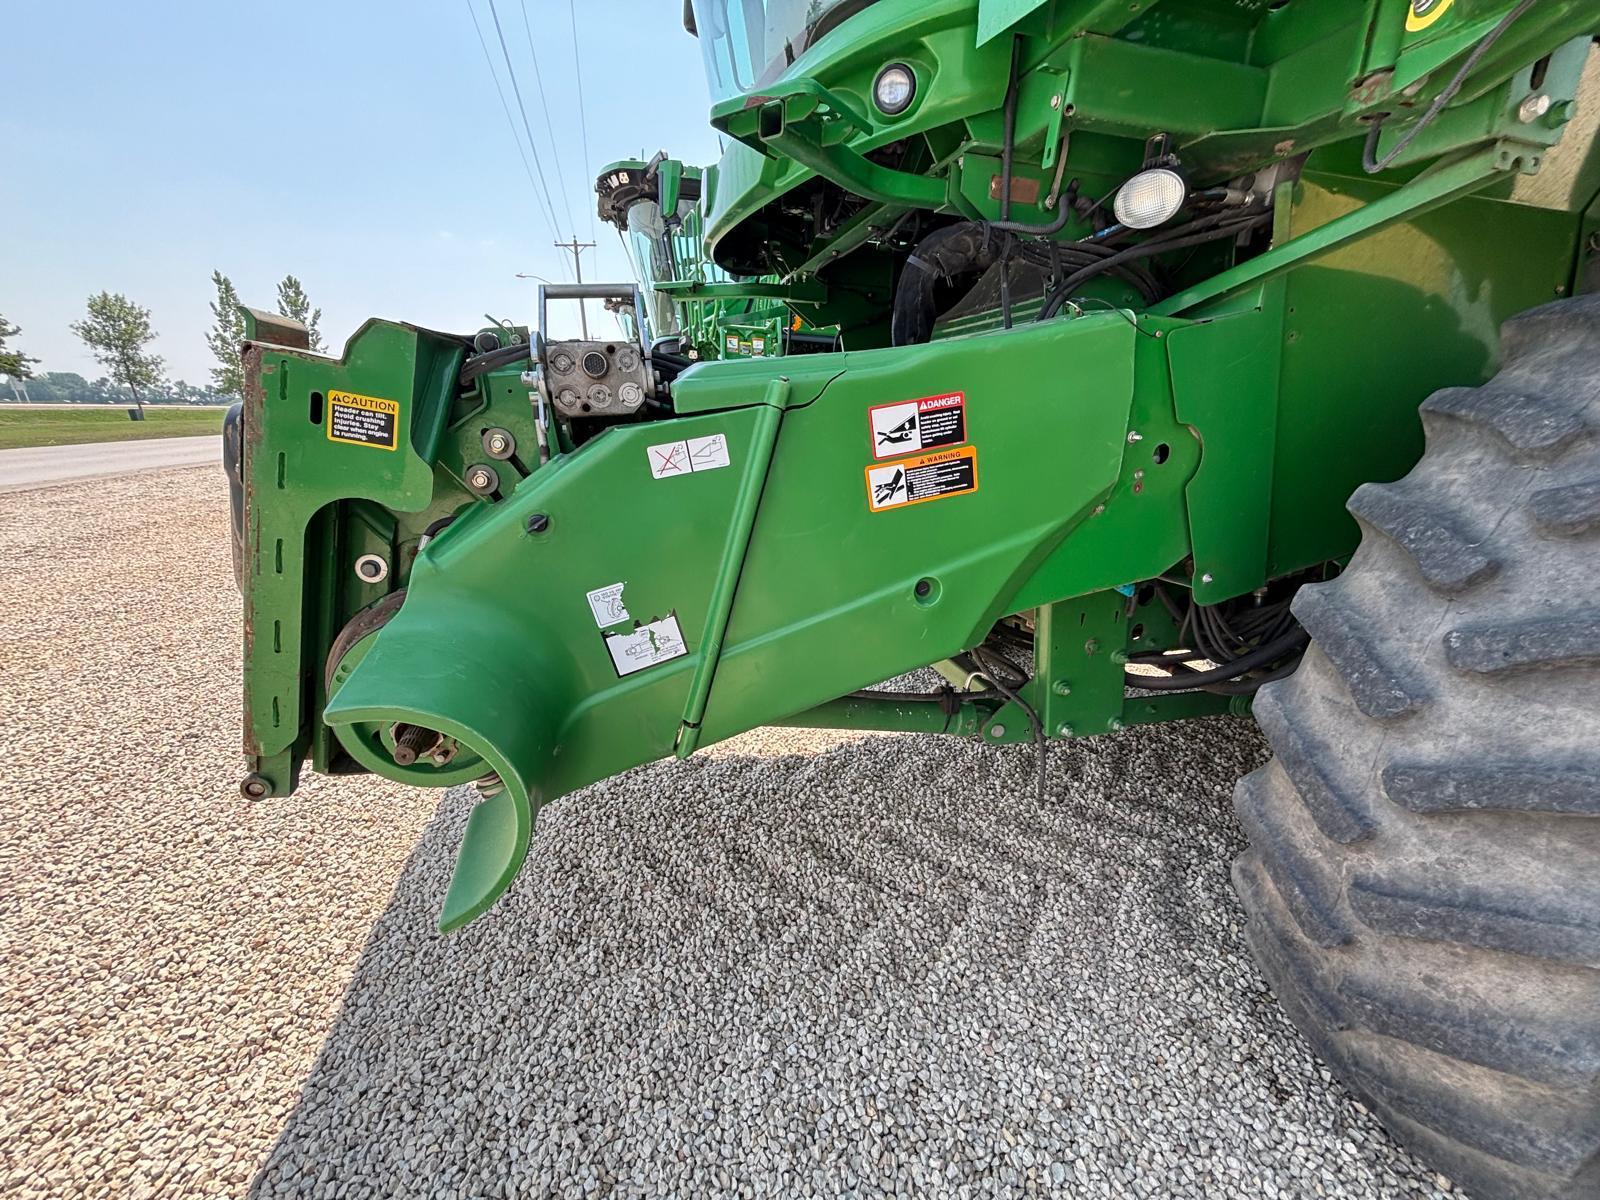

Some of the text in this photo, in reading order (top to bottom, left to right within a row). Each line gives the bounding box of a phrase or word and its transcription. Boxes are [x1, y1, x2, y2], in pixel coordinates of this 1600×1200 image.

[342, 395, 395, 412] CAUTION
[927, 396, 961, 408] DANGER
[334, 405, 359, 415] Header
[334, 412, 385, 426] Avoid crushing
[363, 423, 379, 431] Stay
[341, 431, 368, 441] running.
[368, 430, 389, 438] engine
[928, 451, 961, 463] WARNING
